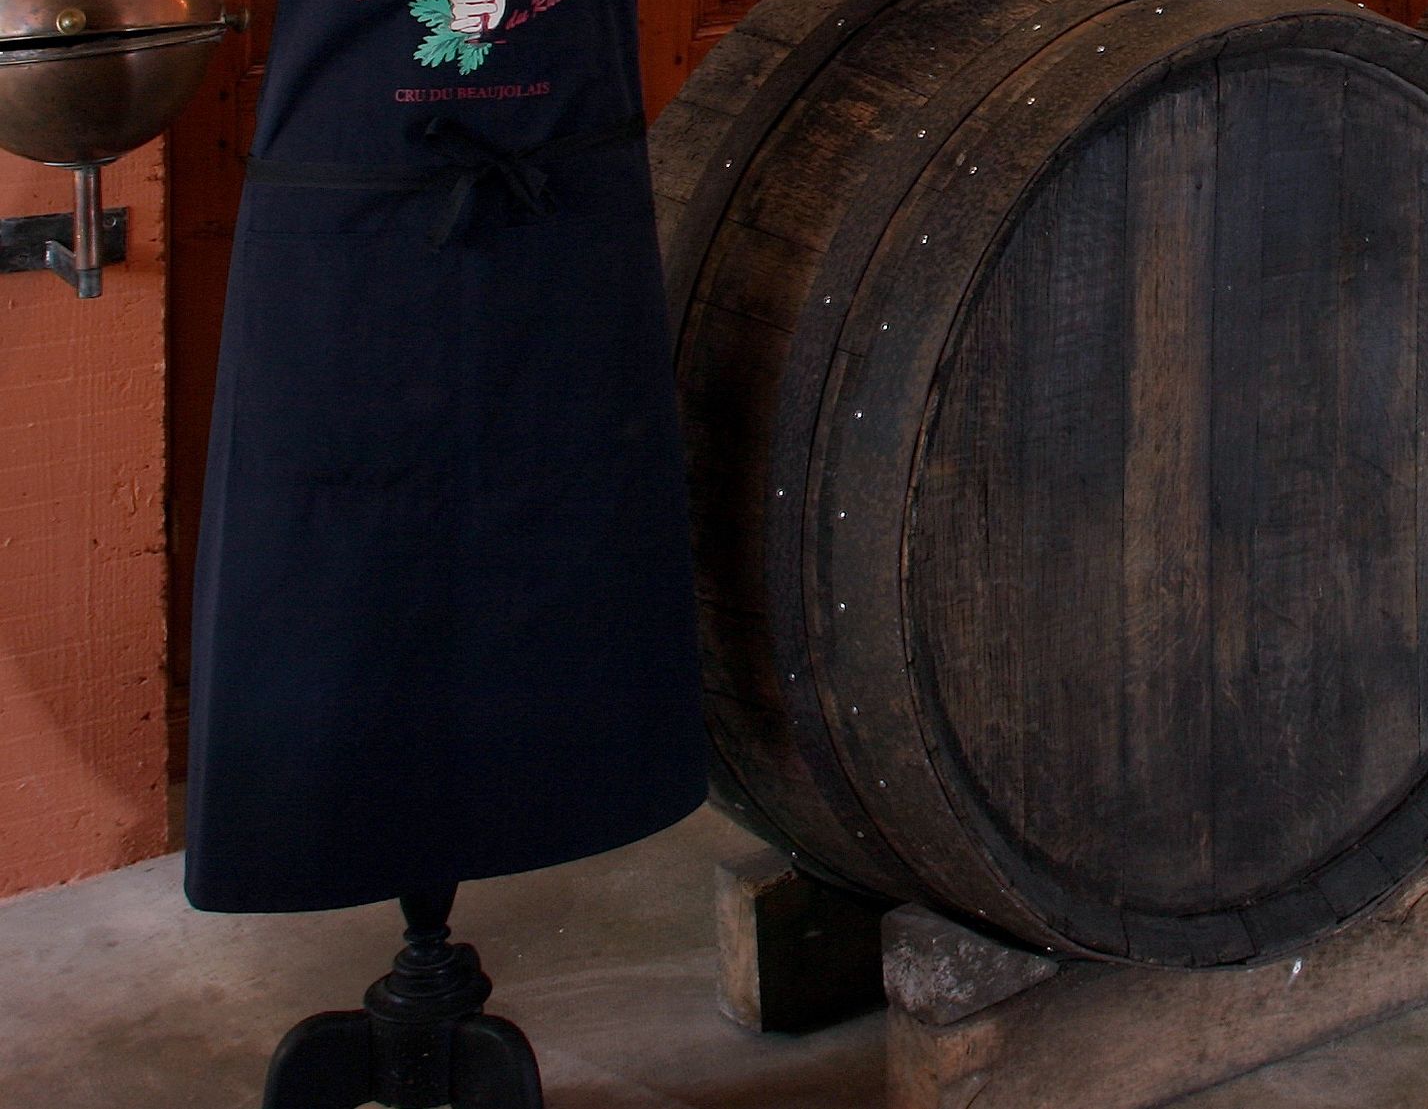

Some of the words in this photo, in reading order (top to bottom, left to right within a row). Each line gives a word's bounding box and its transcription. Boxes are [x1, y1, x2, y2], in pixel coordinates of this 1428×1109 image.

[395, 88, 426, 102] CRU
[430, 87, 453, 101] DU
[457, 82, 551, 101] BEAUJOLAIS
